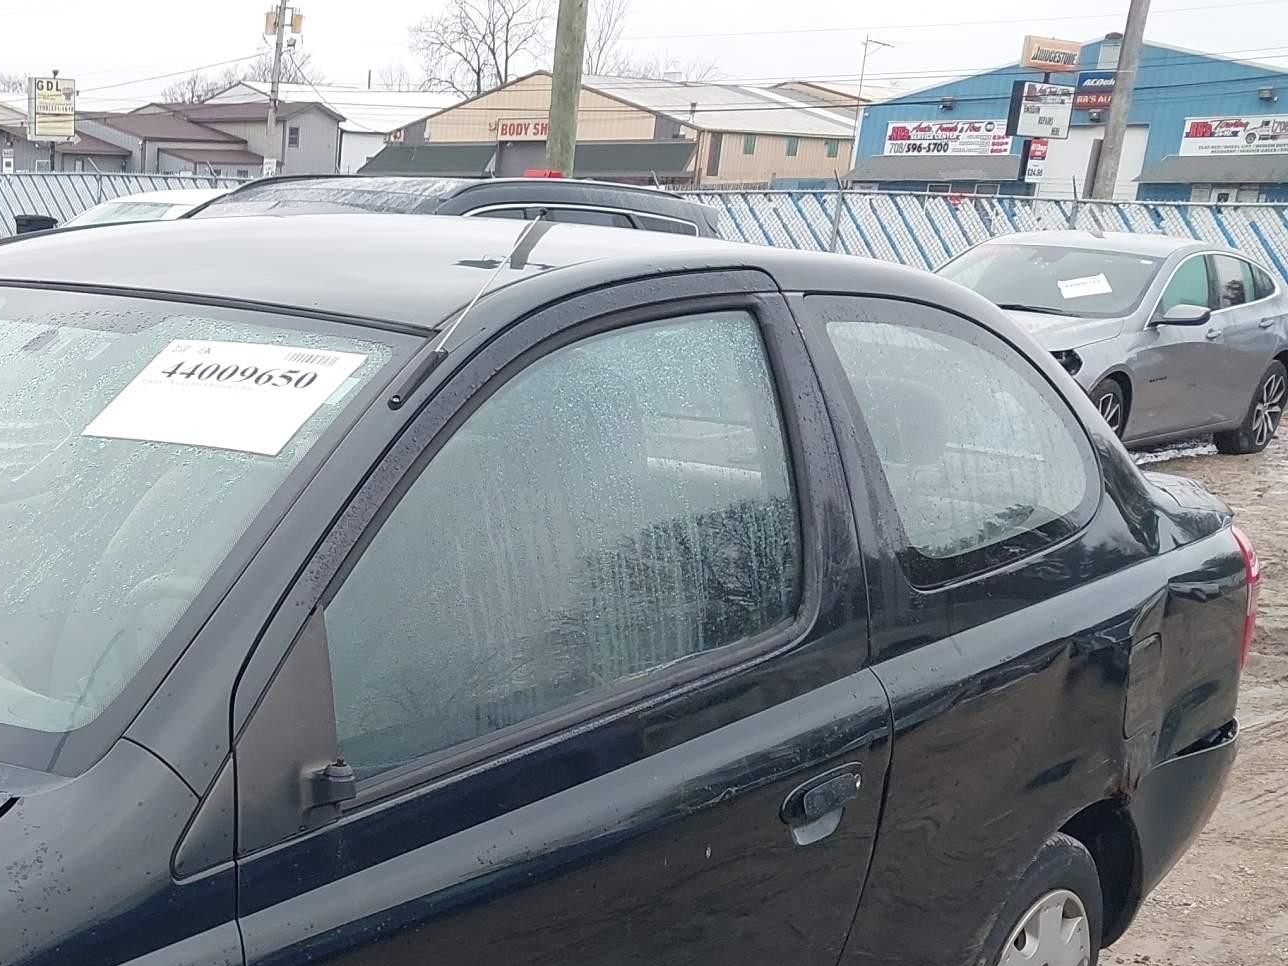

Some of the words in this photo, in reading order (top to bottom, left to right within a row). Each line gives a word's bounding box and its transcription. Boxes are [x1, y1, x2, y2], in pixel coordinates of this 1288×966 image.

[36, 79, 62, 92] GDL
[501, 123, 530, 136] BODY
[532, 123, 551, 136] SH
[161, 360, 319, 390] 44009650
